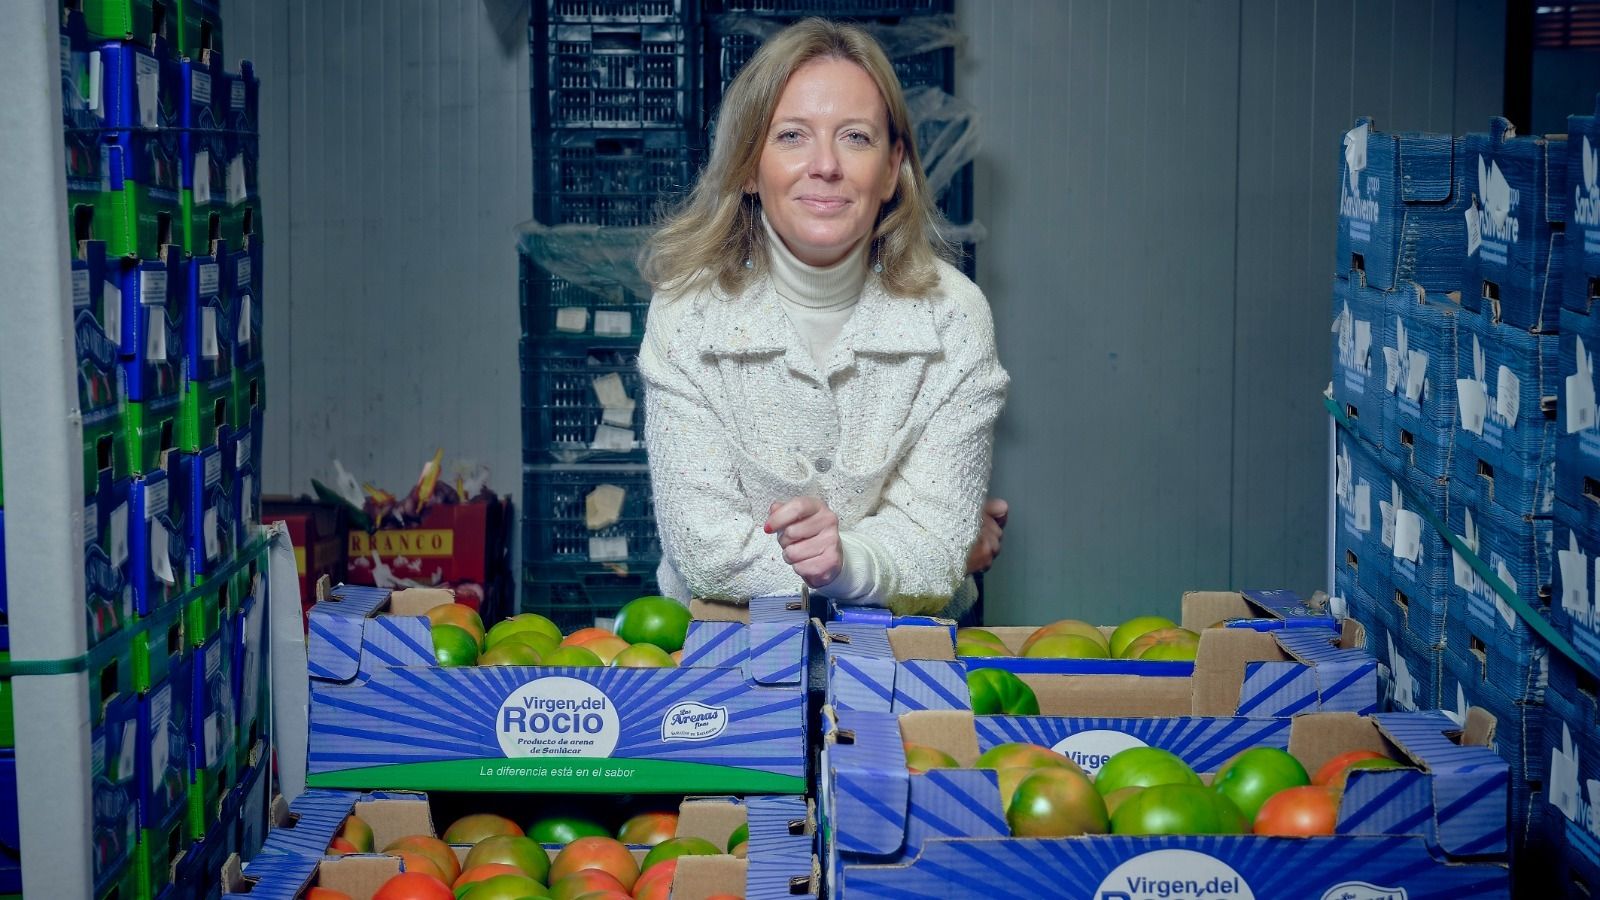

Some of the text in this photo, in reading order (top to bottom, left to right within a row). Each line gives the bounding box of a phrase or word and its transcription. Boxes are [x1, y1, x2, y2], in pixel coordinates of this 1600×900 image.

[351, 534, 442, 551] RRANCO
[523, 696, 606, 712] Virgen del
[503, 705, 604, 734] Rocío
[671, 711, 718, 725] Arenas
[542, 746, 582, 754] Sanlúcar
[1064, 751, 1111, 769] Virge
[479, 766, 636, 777] La diferencia está en el sabor
[1127, 877, 1202, 897] Virgen
[1206, 877, 1239, 893] del
